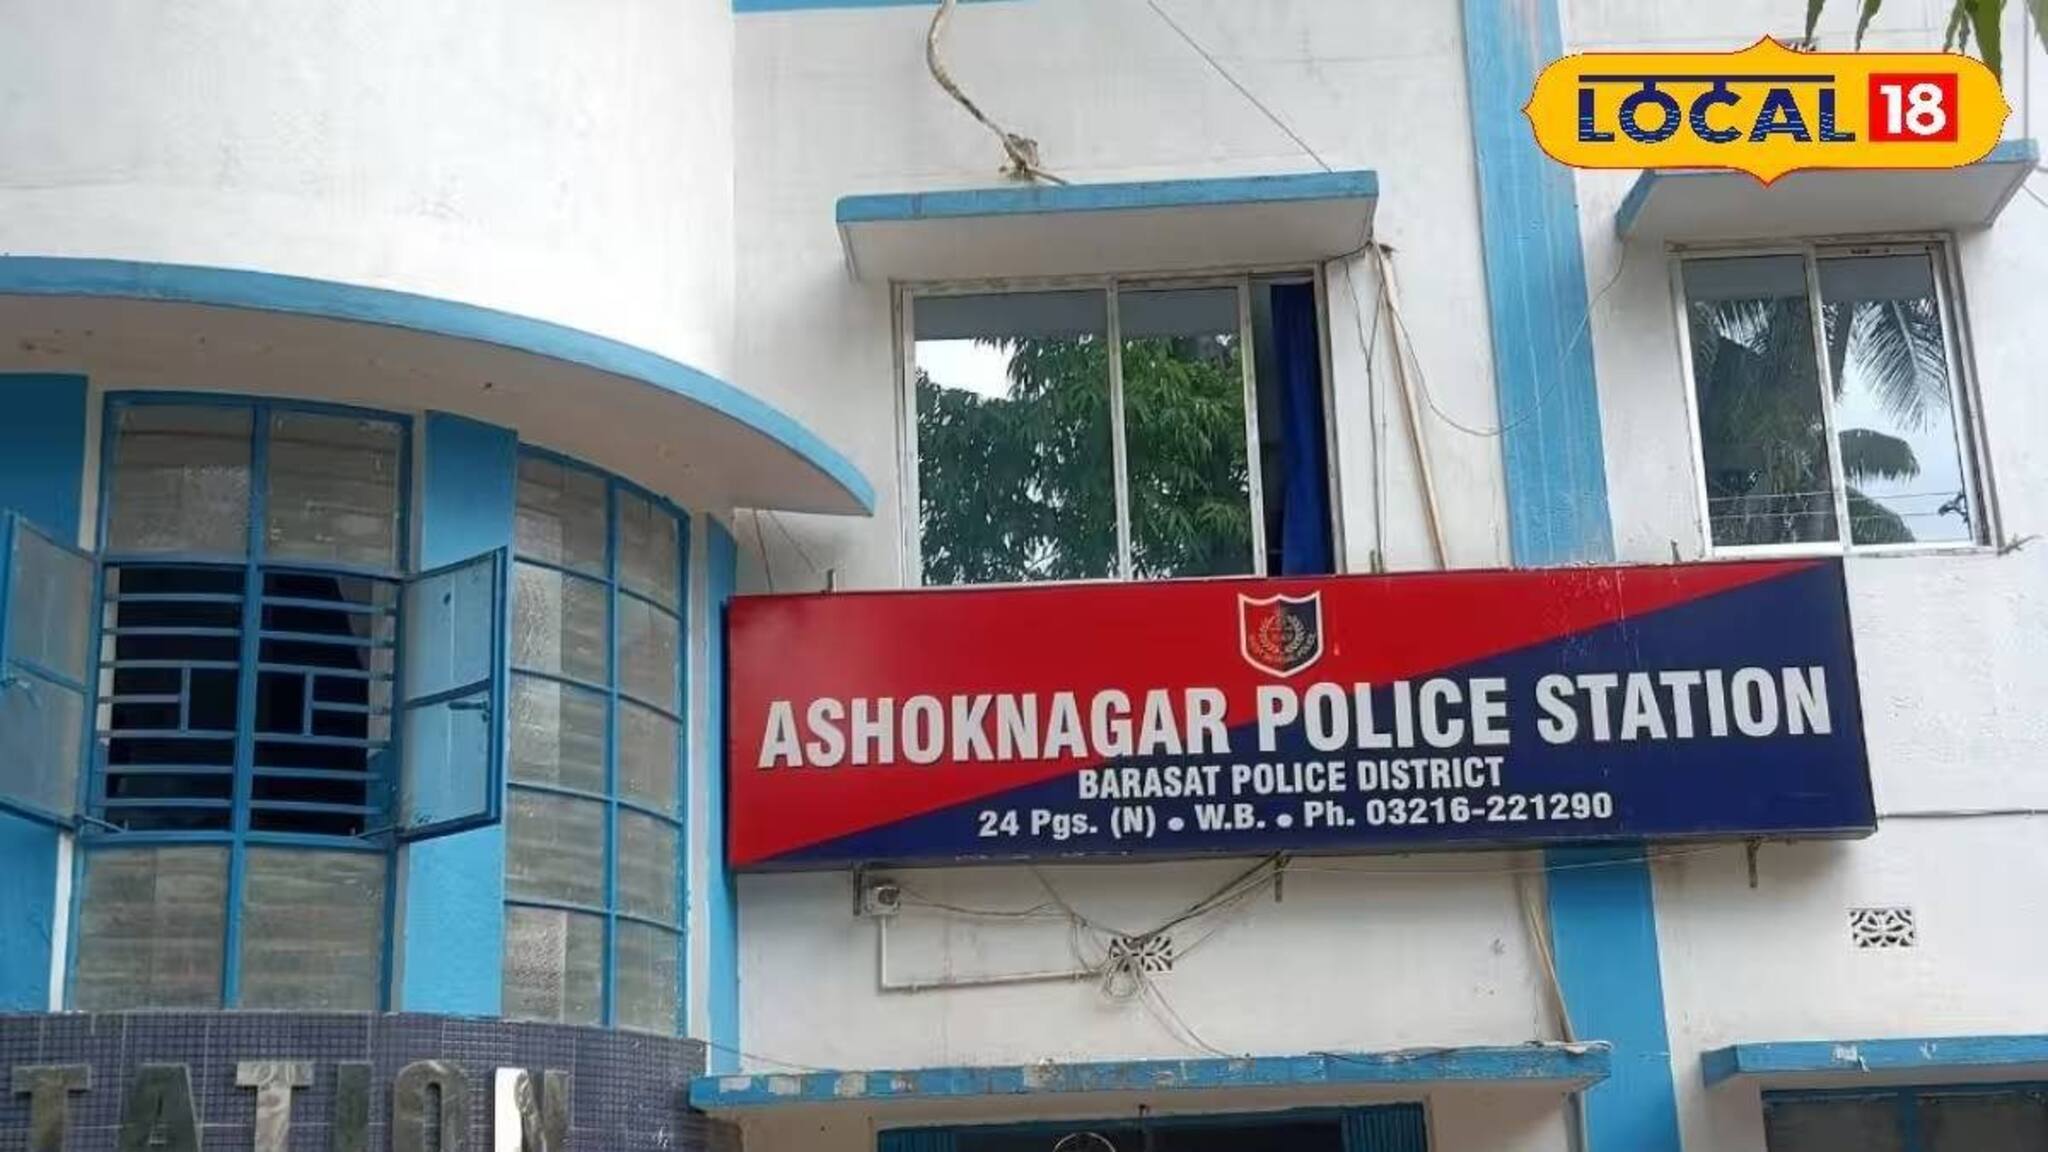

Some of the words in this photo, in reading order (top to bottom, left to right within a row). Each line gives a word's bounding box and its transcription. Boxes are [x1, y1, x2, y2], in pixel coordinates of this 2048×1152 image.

[758, 686, 1231, 768] ASHOKNAGAR
[1256, 677, 1511, 753] POLICE
[1535, 666, 1833, 744] STATION
[1078, 765, 1221, 799] BARASAT
[1231, 761, 1347, 795] POLICE
[1357, 756, 1504, 791] DISTRICT
[979, 810, 1020, 837] 24
[1031, 809, 1098, 841] Pgs.
[1110, 805, 1156, 839] (N)
[1194, 803, 1266, 830] W.B.
[1304, 800, 1355, 827] Ph.
[1366, 792, 1613, 825] 03216-221290
